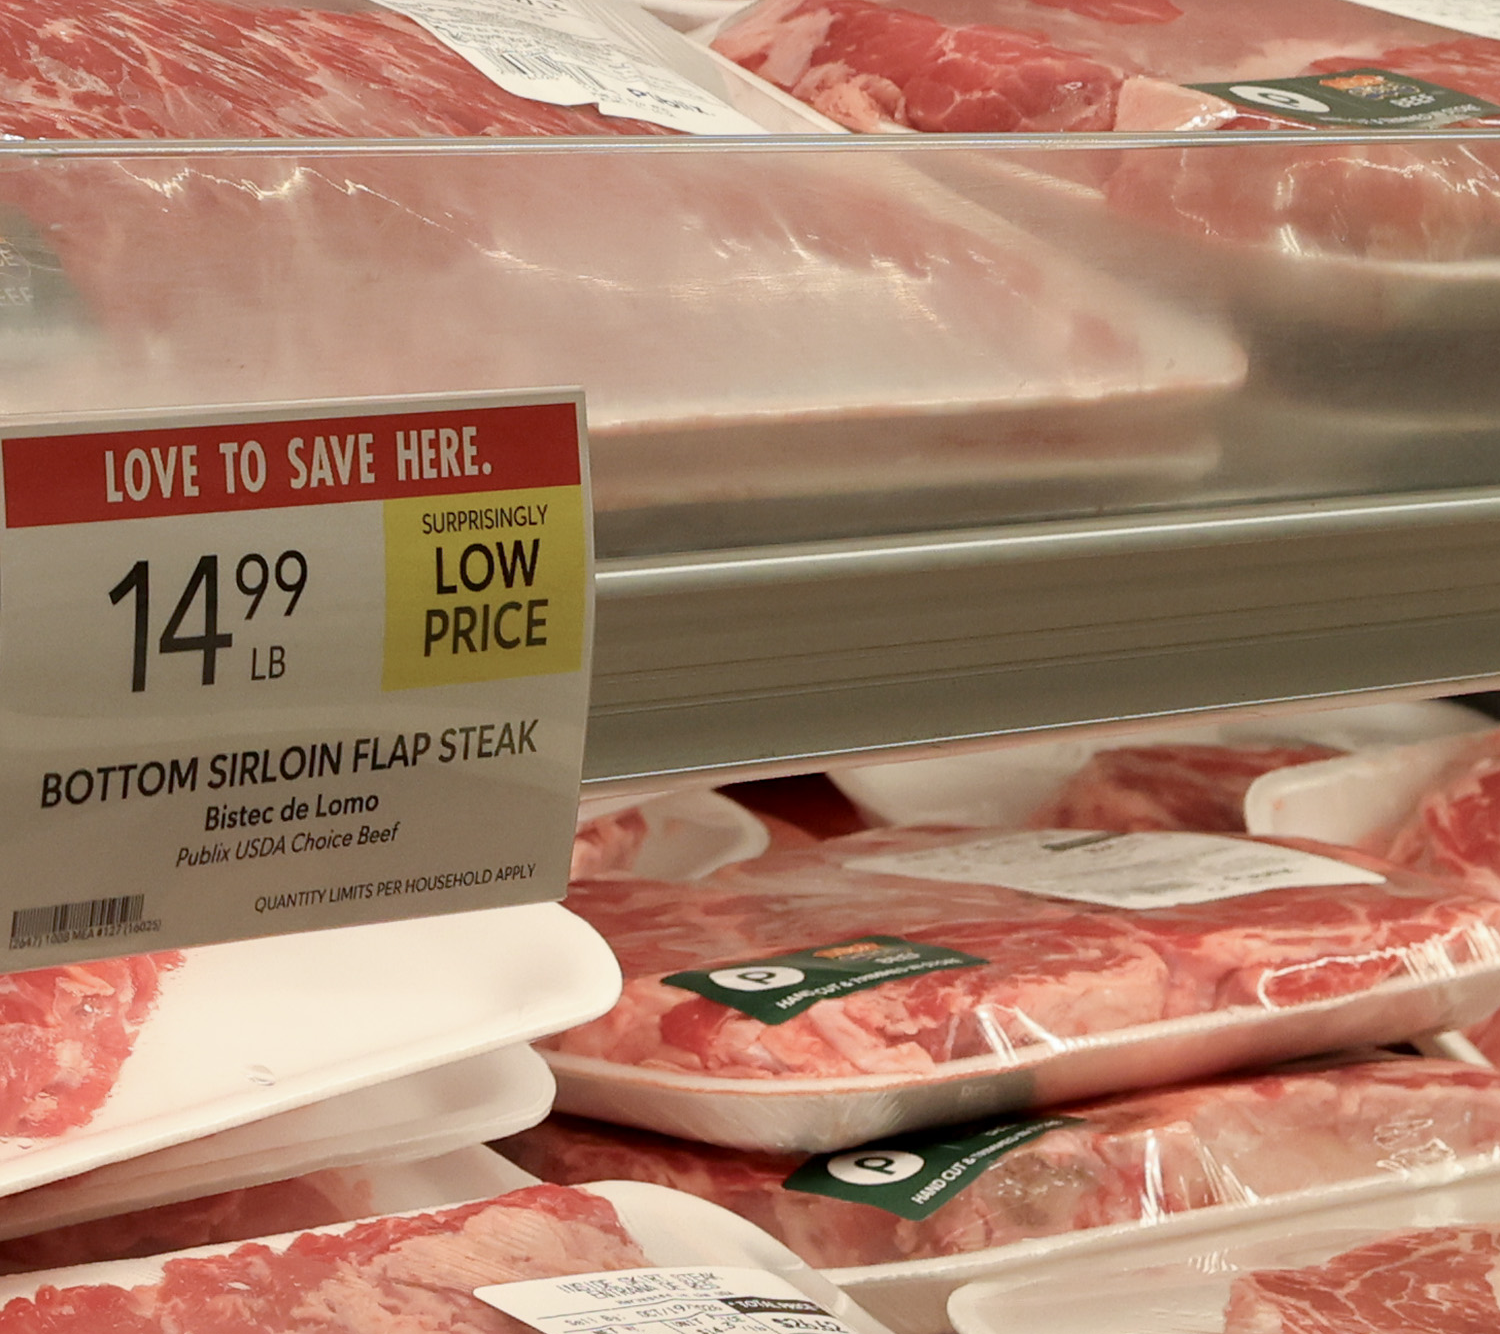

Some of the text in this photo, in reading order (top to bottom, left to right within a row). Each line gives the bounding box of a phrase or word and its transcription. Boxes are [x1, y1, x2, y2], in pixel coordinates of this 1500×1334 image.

[105, 425, 493, 502] LOVE TO SAVE HERE.
[421, 504, 549, 535] SURPRISINGLY
[435, 539, 541, 595] LOW
[423, 599, 550, 657] PRICE
[250, 646, 286, 681] LB
[41, 719, 540, 809] BOTTOM SIRLOIN FLAP STEAK
[204, 791, 380, 832] Bistec de Lomo
[176, 822, 401, 868] Publix USDA Choice Beef
[254, 864, 536, 915] QUANTITY LIMITS PER HOUSEHOLD APPLY
[911, 1178, 948, 1205] HAND
[942, 1161, 967, 1182] CUT
